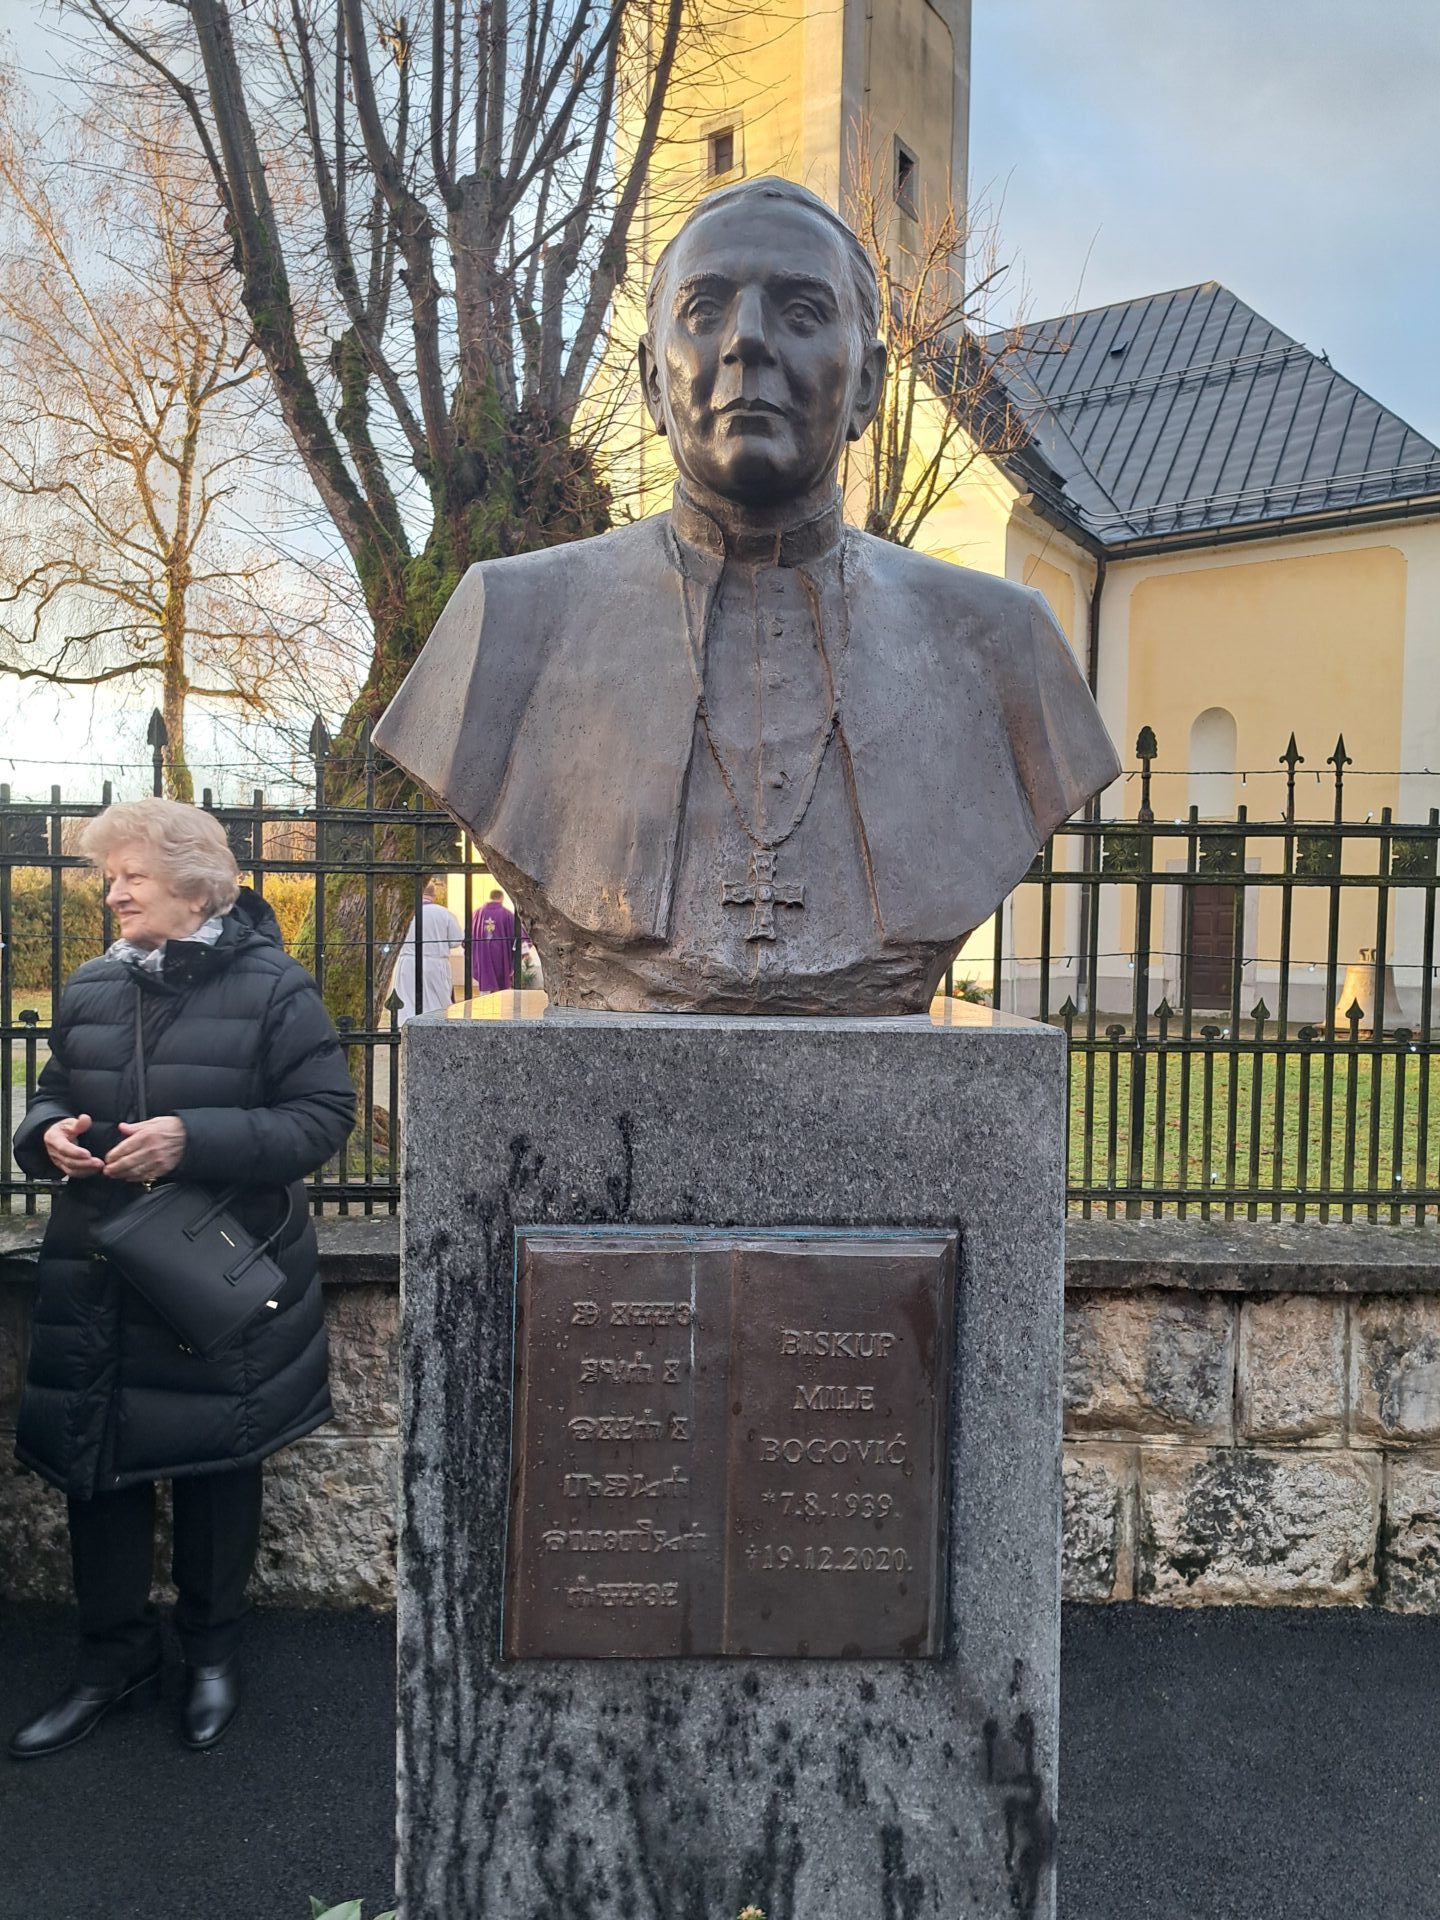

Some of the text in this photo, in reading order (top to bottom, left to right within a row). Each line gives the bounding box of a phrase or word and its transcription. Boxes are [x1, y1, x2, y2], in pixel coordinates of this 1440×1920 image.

[780, 1329, 896, 1358] BISKUP
[793, 1385, 875, 1411] MILE
[760, 1433, 907, 1463] BOGOVIĆ
